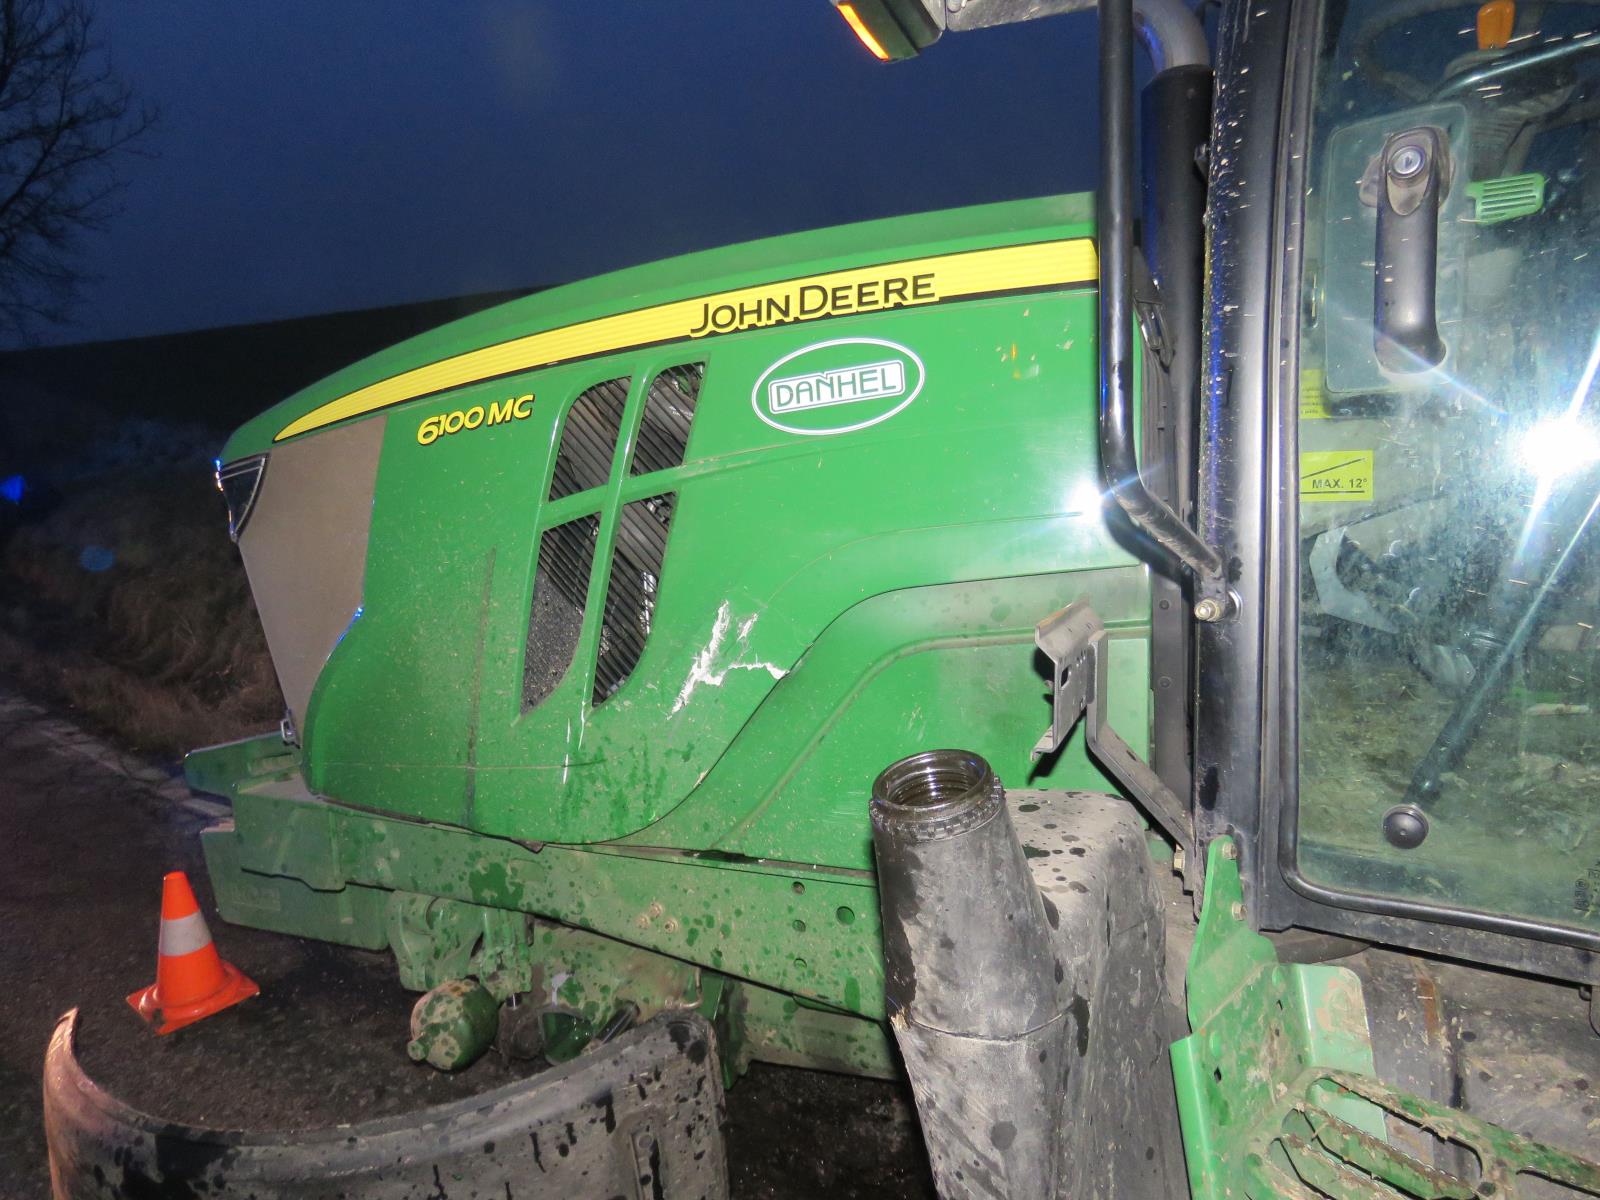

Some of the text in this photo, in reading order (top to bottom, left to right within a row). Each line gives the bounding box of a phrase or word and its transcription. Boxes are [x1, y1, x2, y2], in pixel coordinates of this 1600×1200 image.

[690, 273, 936, 334] JOHN DEERE
[417, 393, 536, 445] 6100 MC
[1312, 478, 1344, 489] MAX.
